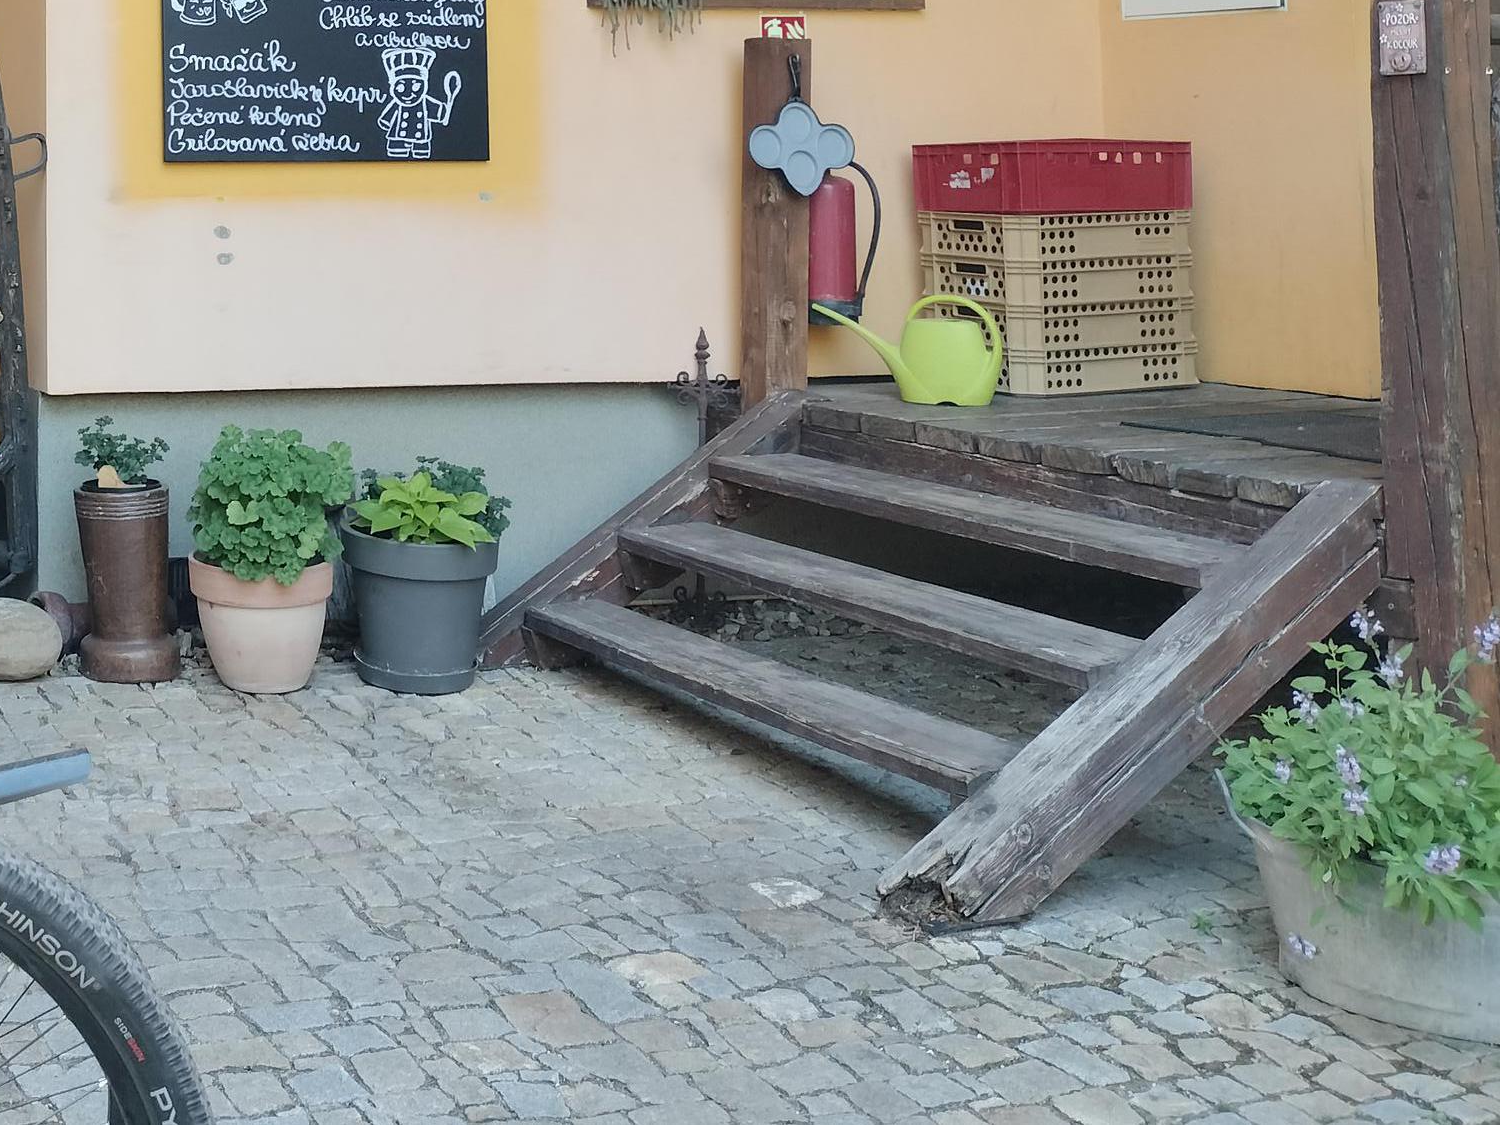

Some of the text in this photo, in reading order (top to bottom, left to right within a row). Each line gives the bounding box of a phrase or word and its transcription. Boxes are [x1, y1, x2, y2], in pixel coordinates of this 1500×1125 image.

[319, 5, 377, 30] Chléb
[377, 11, 401, 28] se
[169, 39, 297, 73] Smažák
[327, 77, 387, 113] kapr
[167, 99, 321, 128] Pečené koleno
[167, 128, 288, 154] Grilovaná
